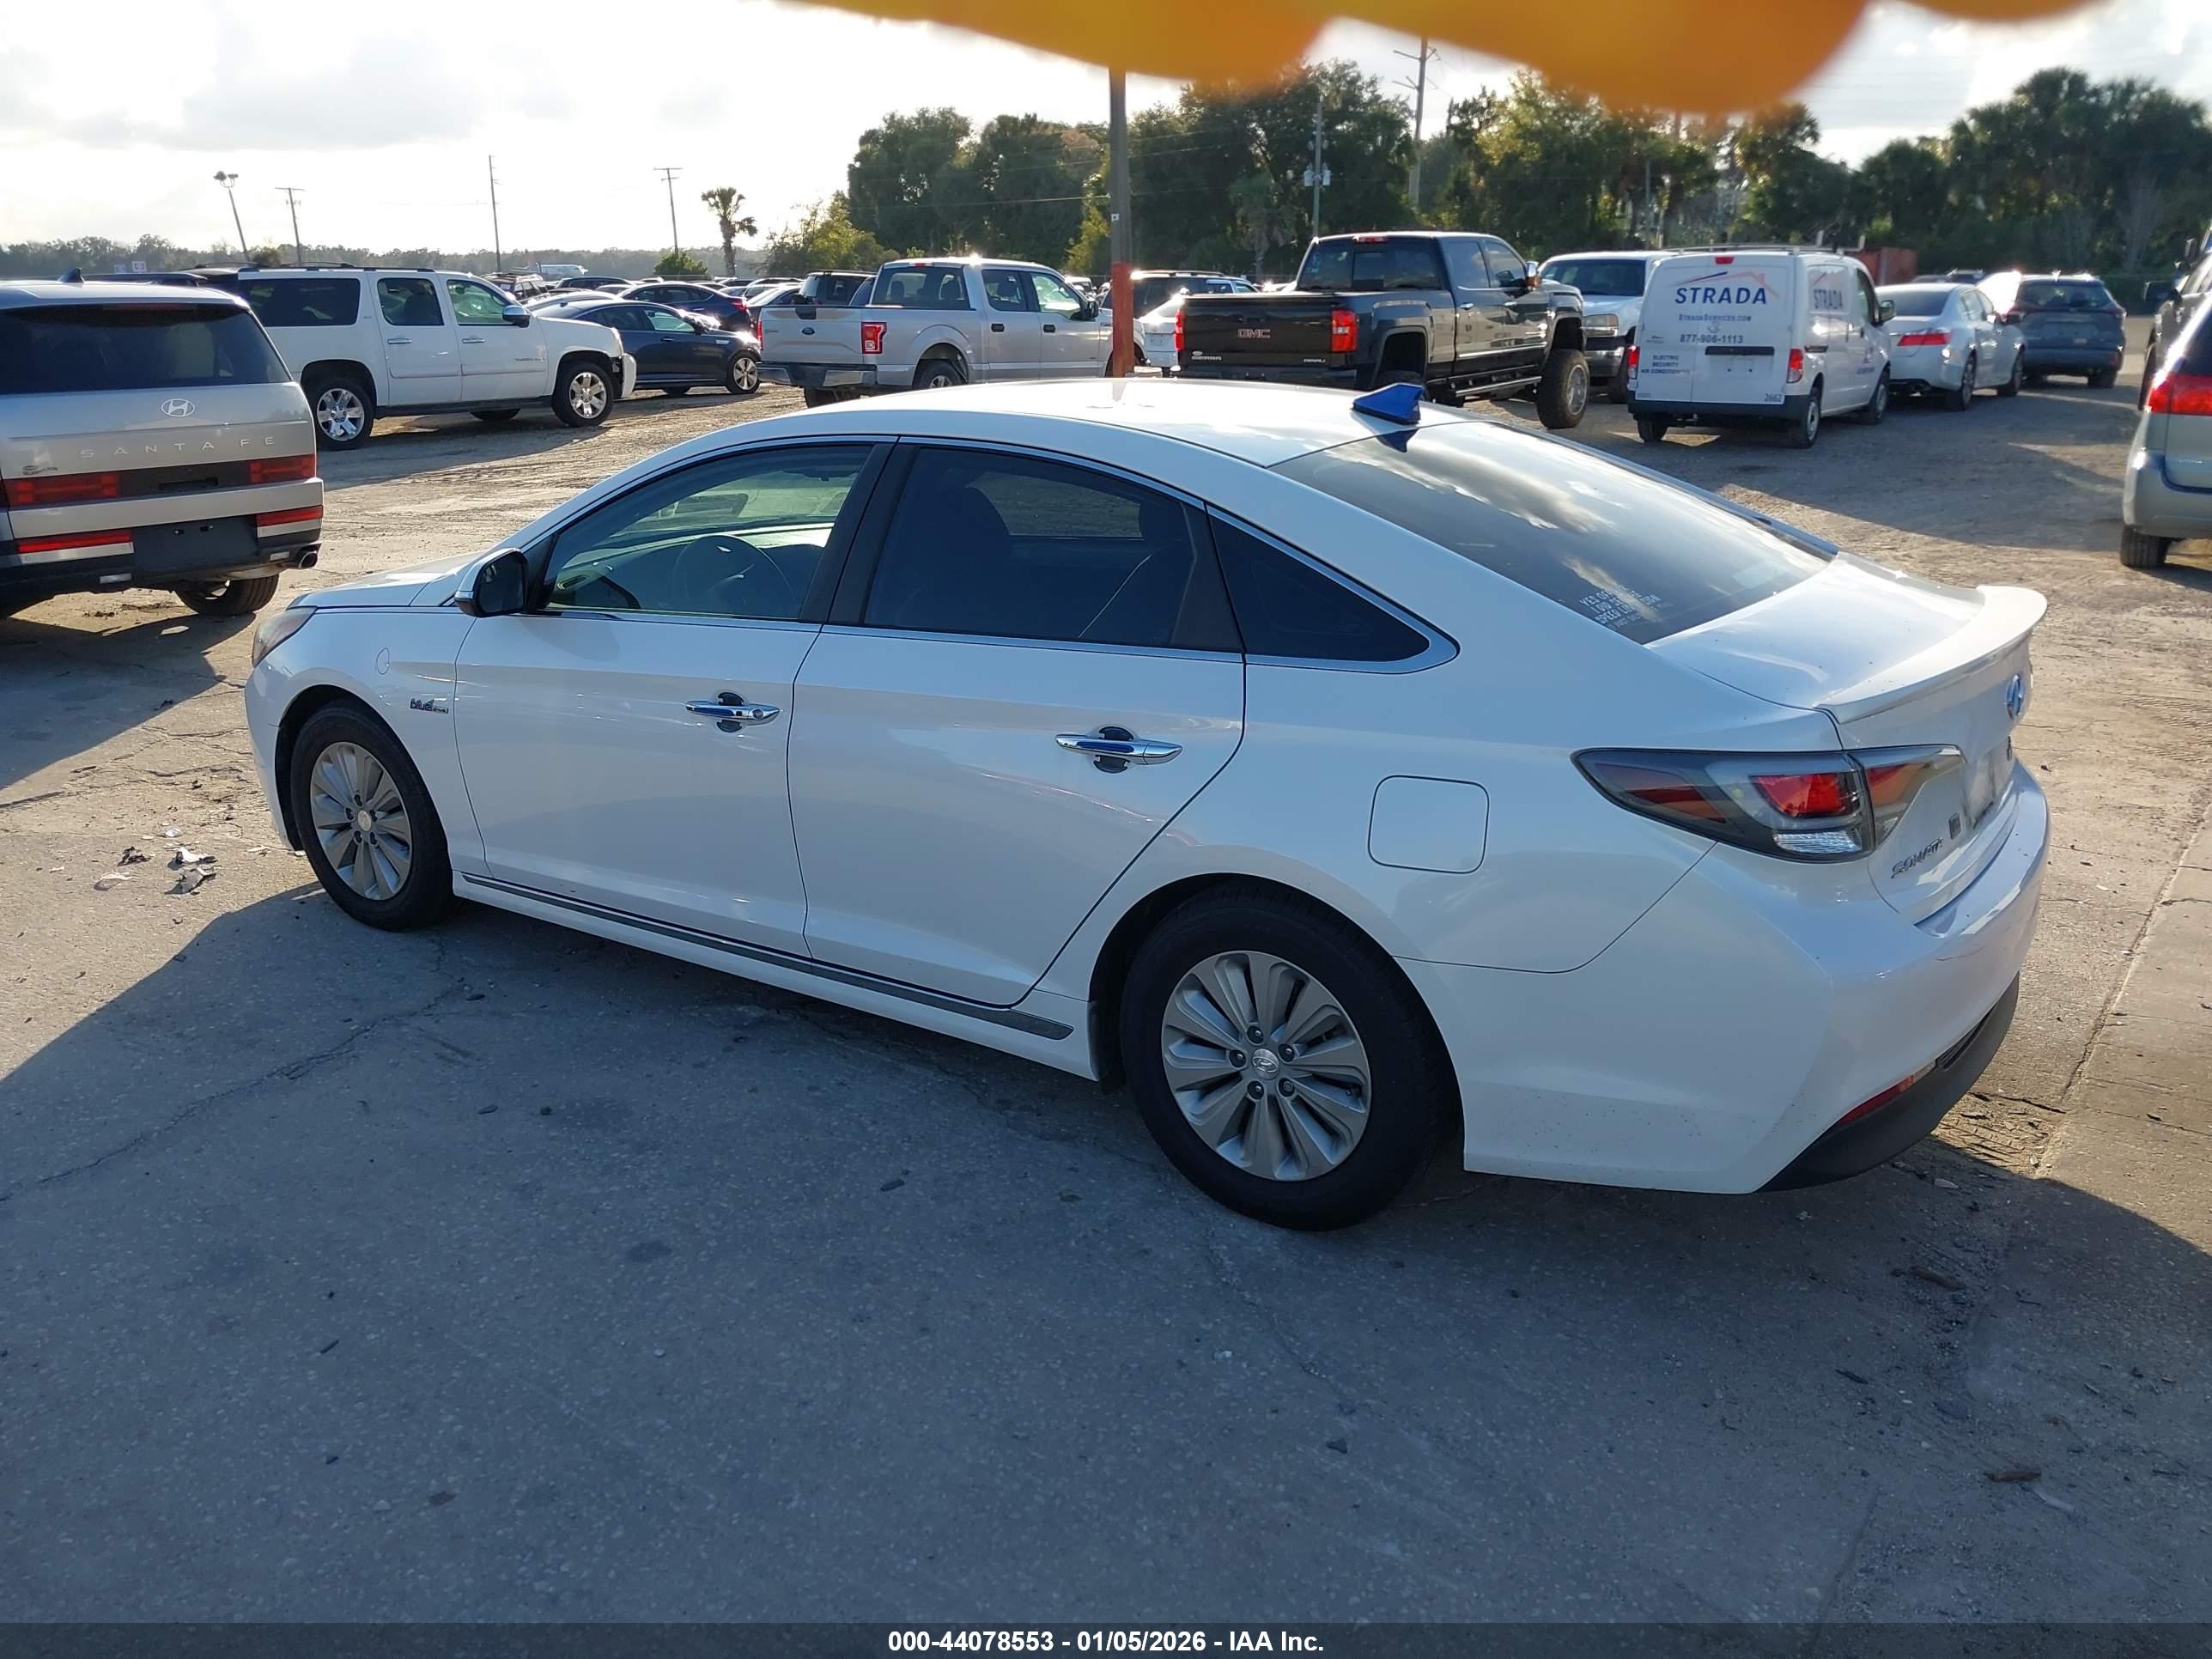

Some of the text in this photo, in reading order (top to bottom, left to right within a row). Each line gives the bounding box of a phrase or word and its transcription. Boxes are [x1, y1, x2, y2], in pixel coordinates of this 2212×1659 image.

[1674, 287, 1767, 305] STRADA
[1237, 329, 1271, 338] GMC
[1680, 334, 1744, 343] 877-906-1113
[80, 435, 276, 459] SANTA FE
[1579, 594, 1600, 606] YES
[1594, 608, 1621, 624] SPEED
